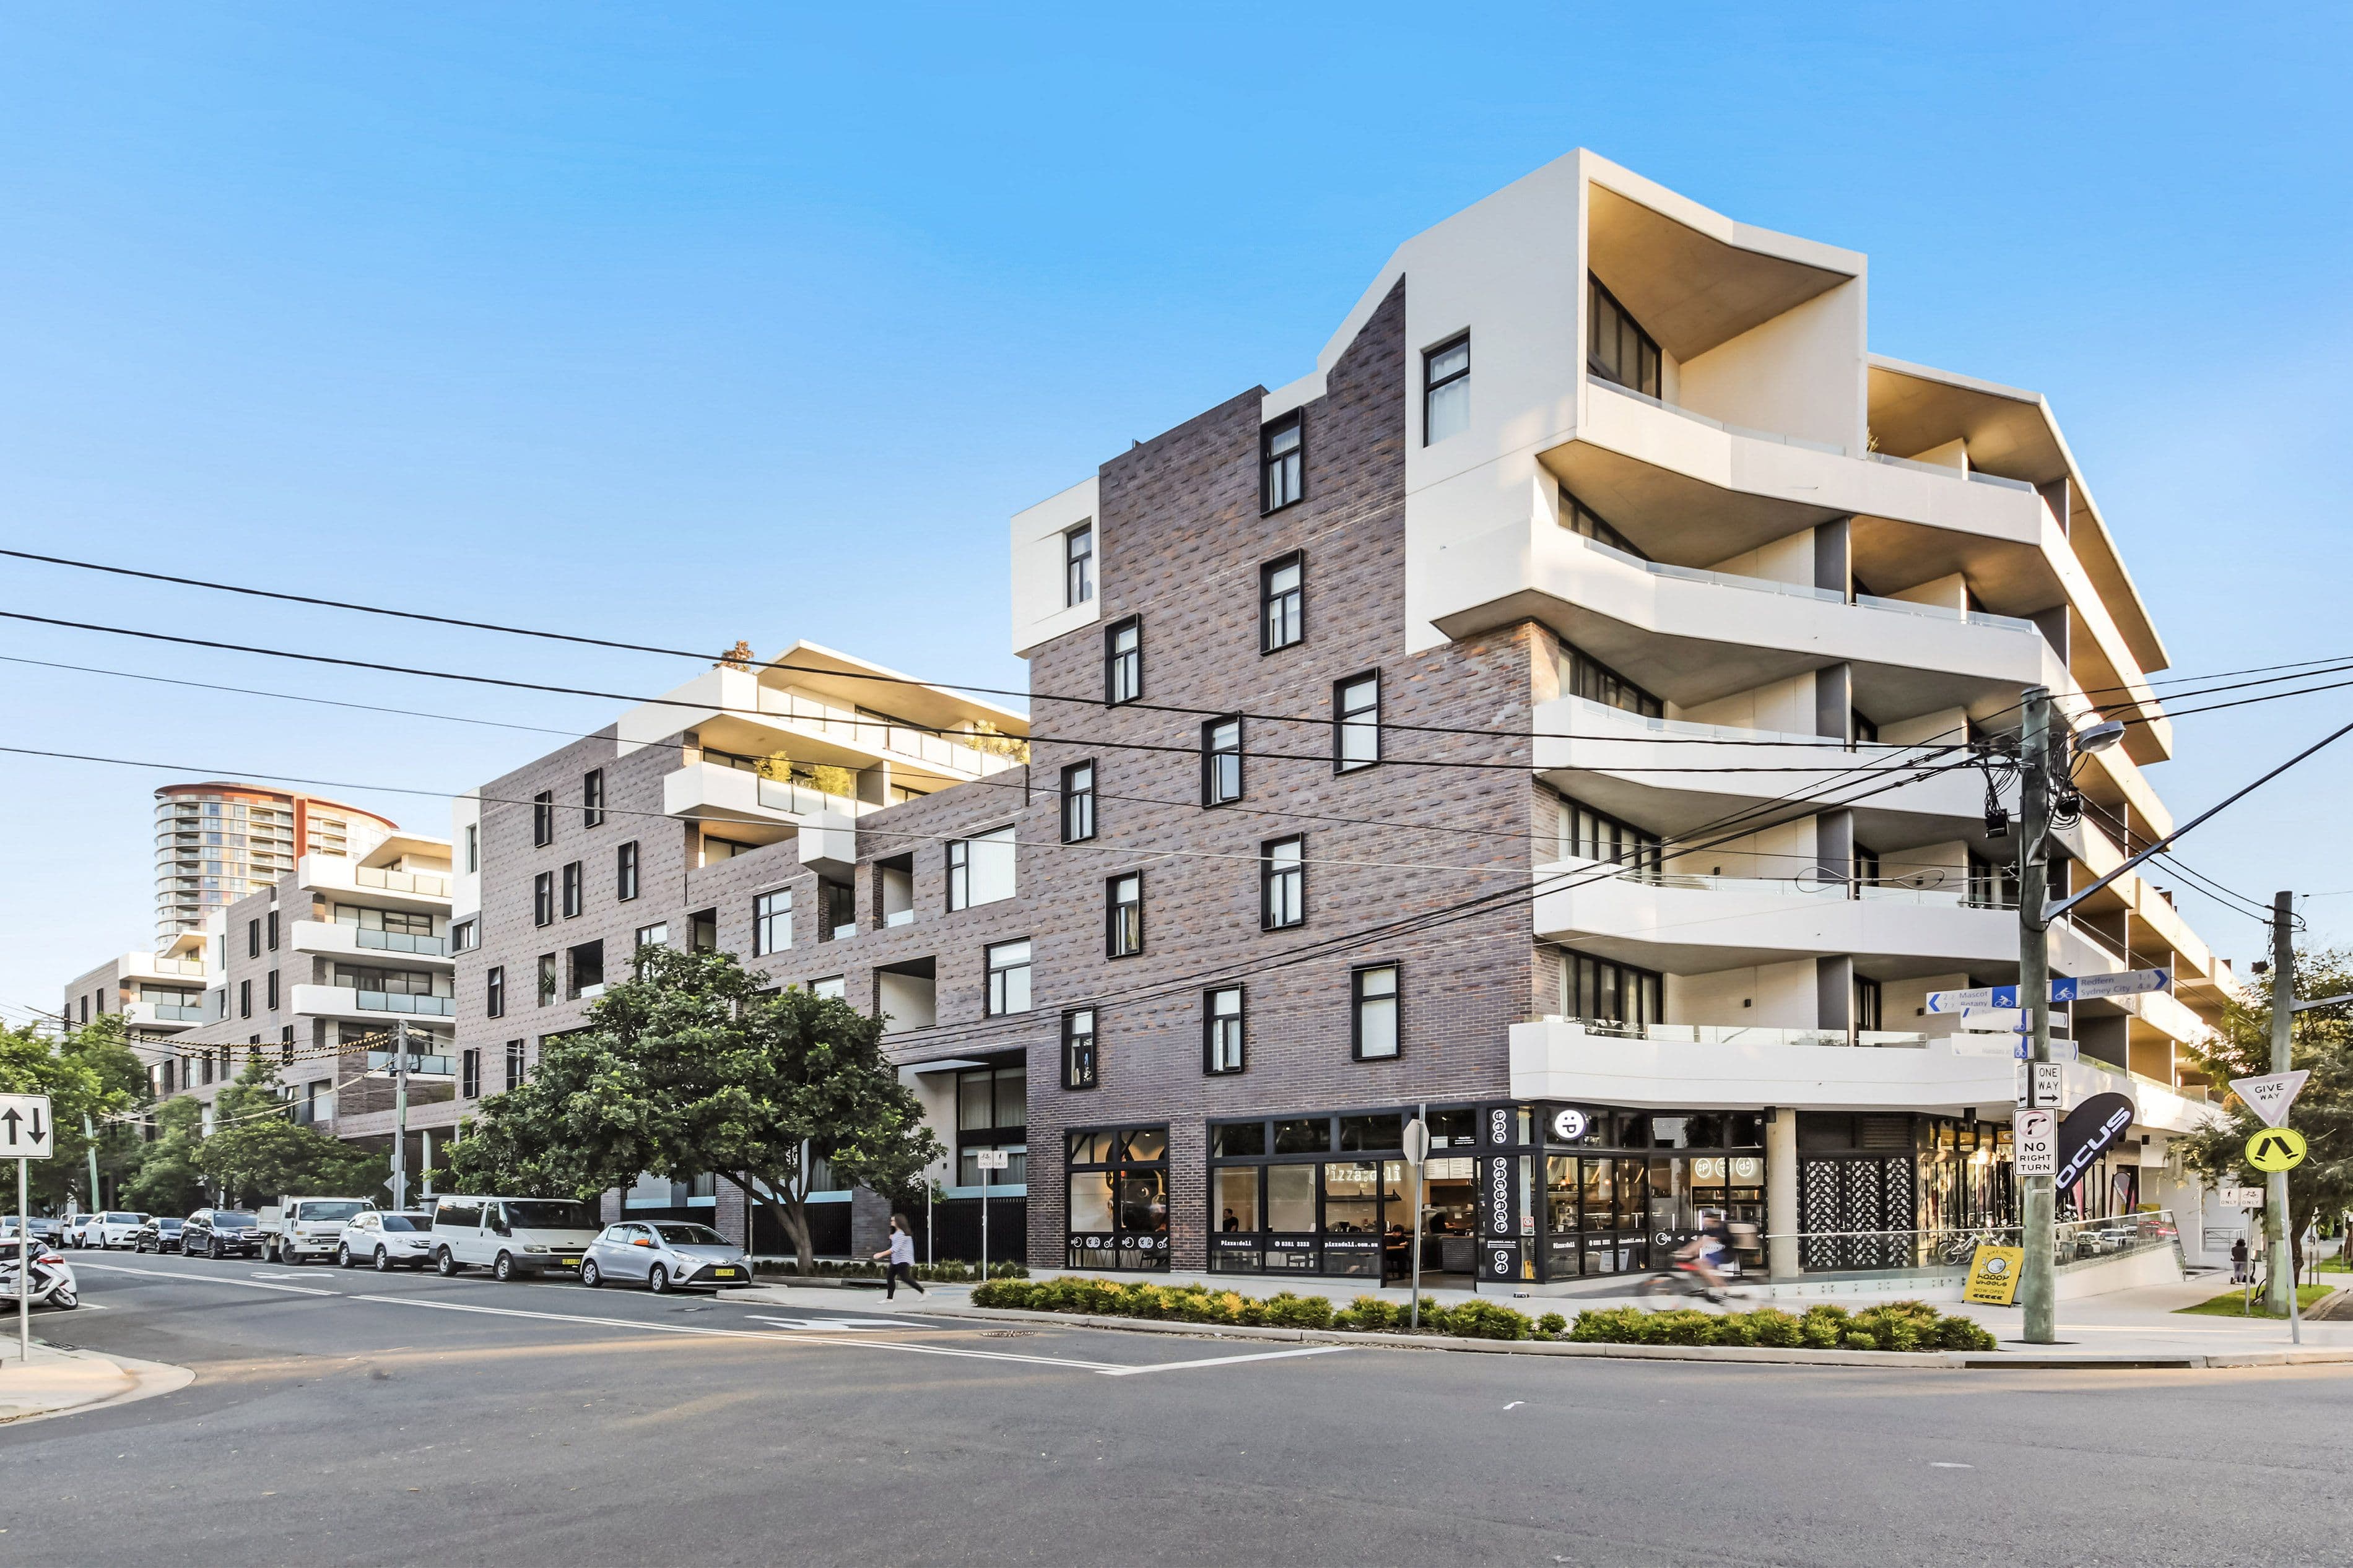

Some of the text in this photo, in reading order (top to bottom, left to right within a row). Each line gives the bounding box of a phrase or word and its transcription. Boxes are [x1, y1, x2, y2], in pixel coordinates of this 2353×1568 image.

[2081, 977, 2114, 985] Redfern
[2081, 987, 2110, 996] Sydney
[2113, 984, 2131, 994] City
[2039, 1067, 2058, 1077] ONE
[2038, 1081, 2059, 1090] WAY
[2255, 1083, 2284, 1093] GIVE
[2259, 1093, 2280, 1101] WAY
[2024, 1142, 2046, 1152] NO
